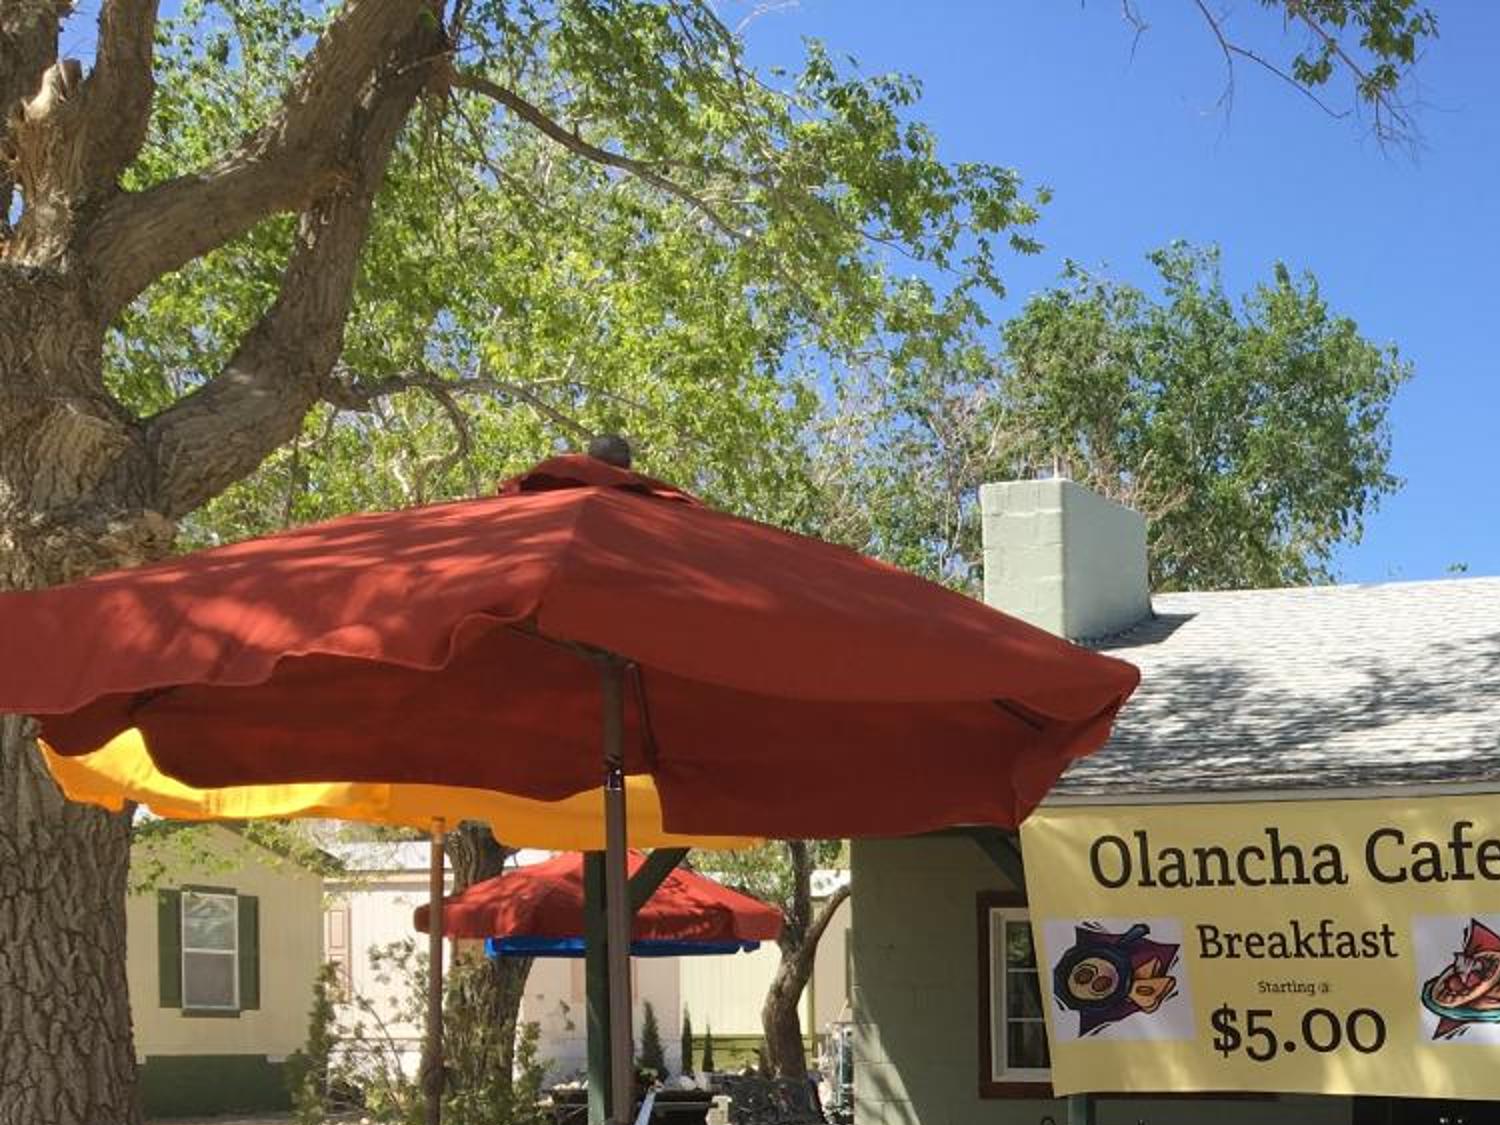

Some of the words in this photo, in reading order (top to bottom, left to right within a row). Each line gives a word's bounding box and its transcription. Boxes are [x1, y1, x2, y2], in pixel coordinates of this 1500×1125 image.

[1089, 827, 1348, 889] Olancha
[1196, 919, 1399, 960] Breakfast
[1257, 980, 1315, 997] Starting
[1212, 1003, 1386, 1062] $5.00
